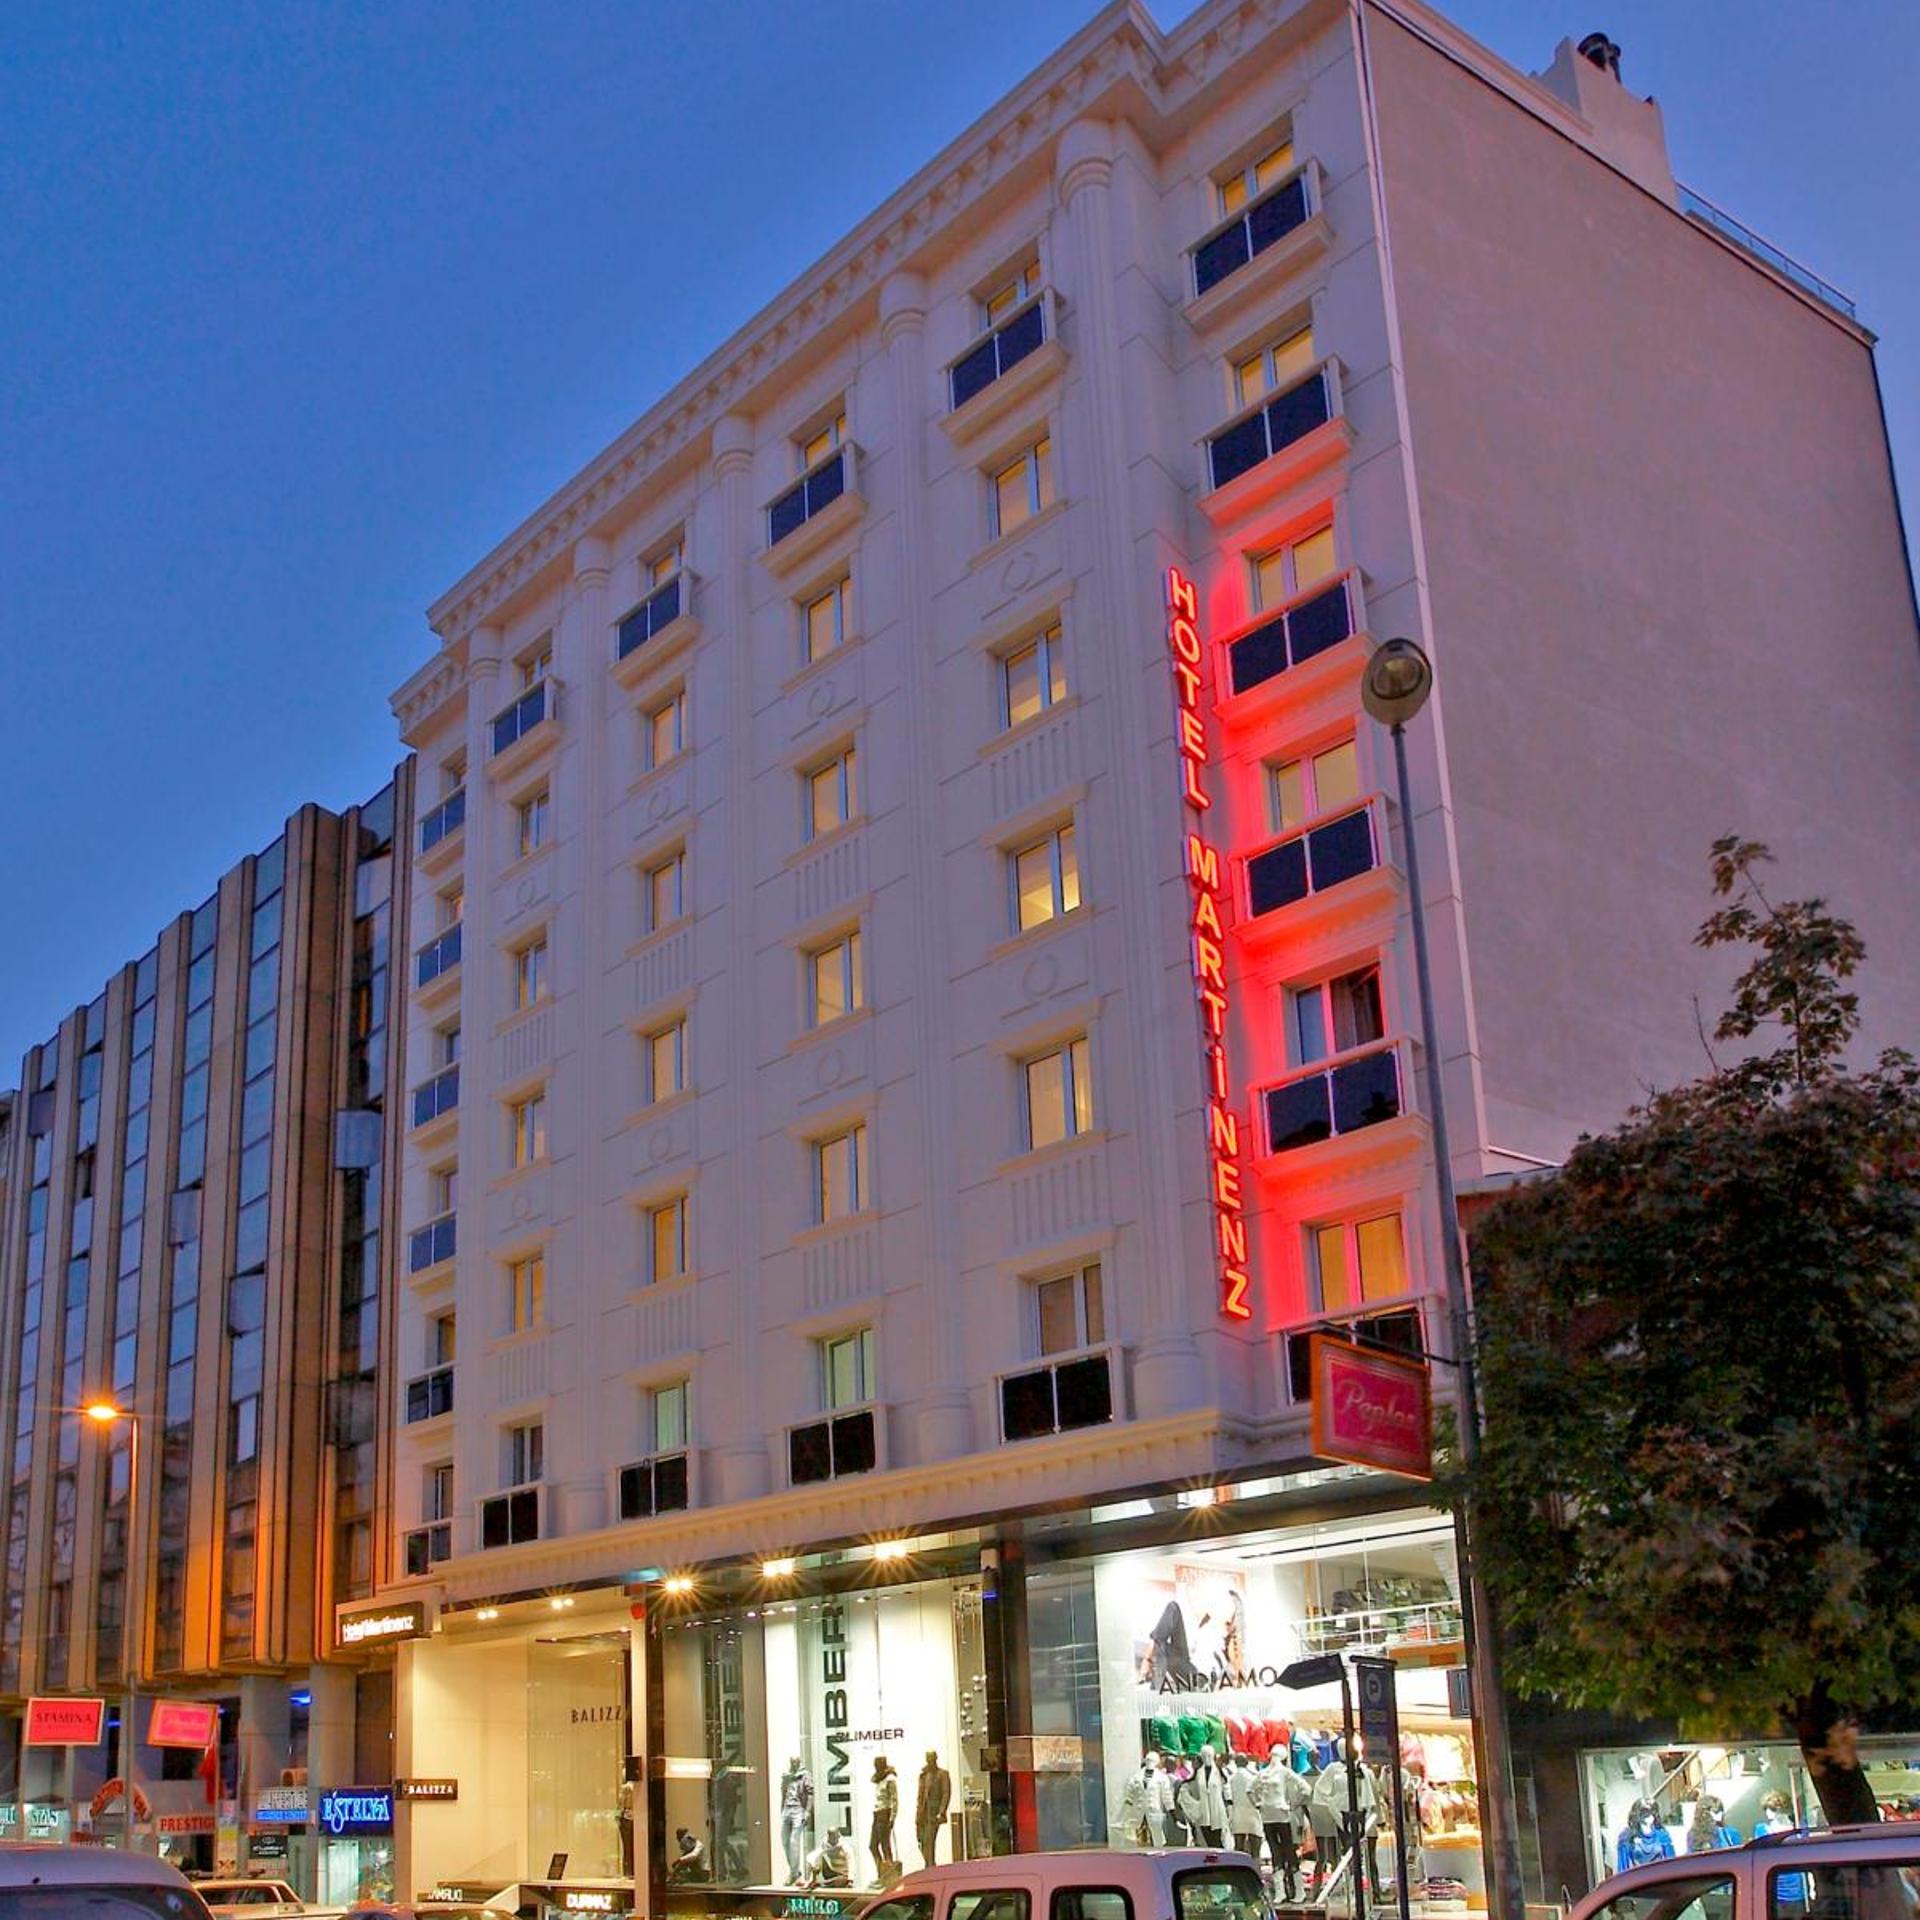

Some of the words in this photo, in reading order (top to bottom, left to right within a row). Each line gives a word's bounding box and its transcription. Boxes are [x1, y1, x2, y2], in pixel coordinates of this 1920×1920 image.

[1166, 567, 1211, 809] HOTEL
[822, 1604, 852, 1837] LIMBER
[845, 1728, 904, 1742] LIMBER
[408, 1784, 454, 1795] BALIZZA
